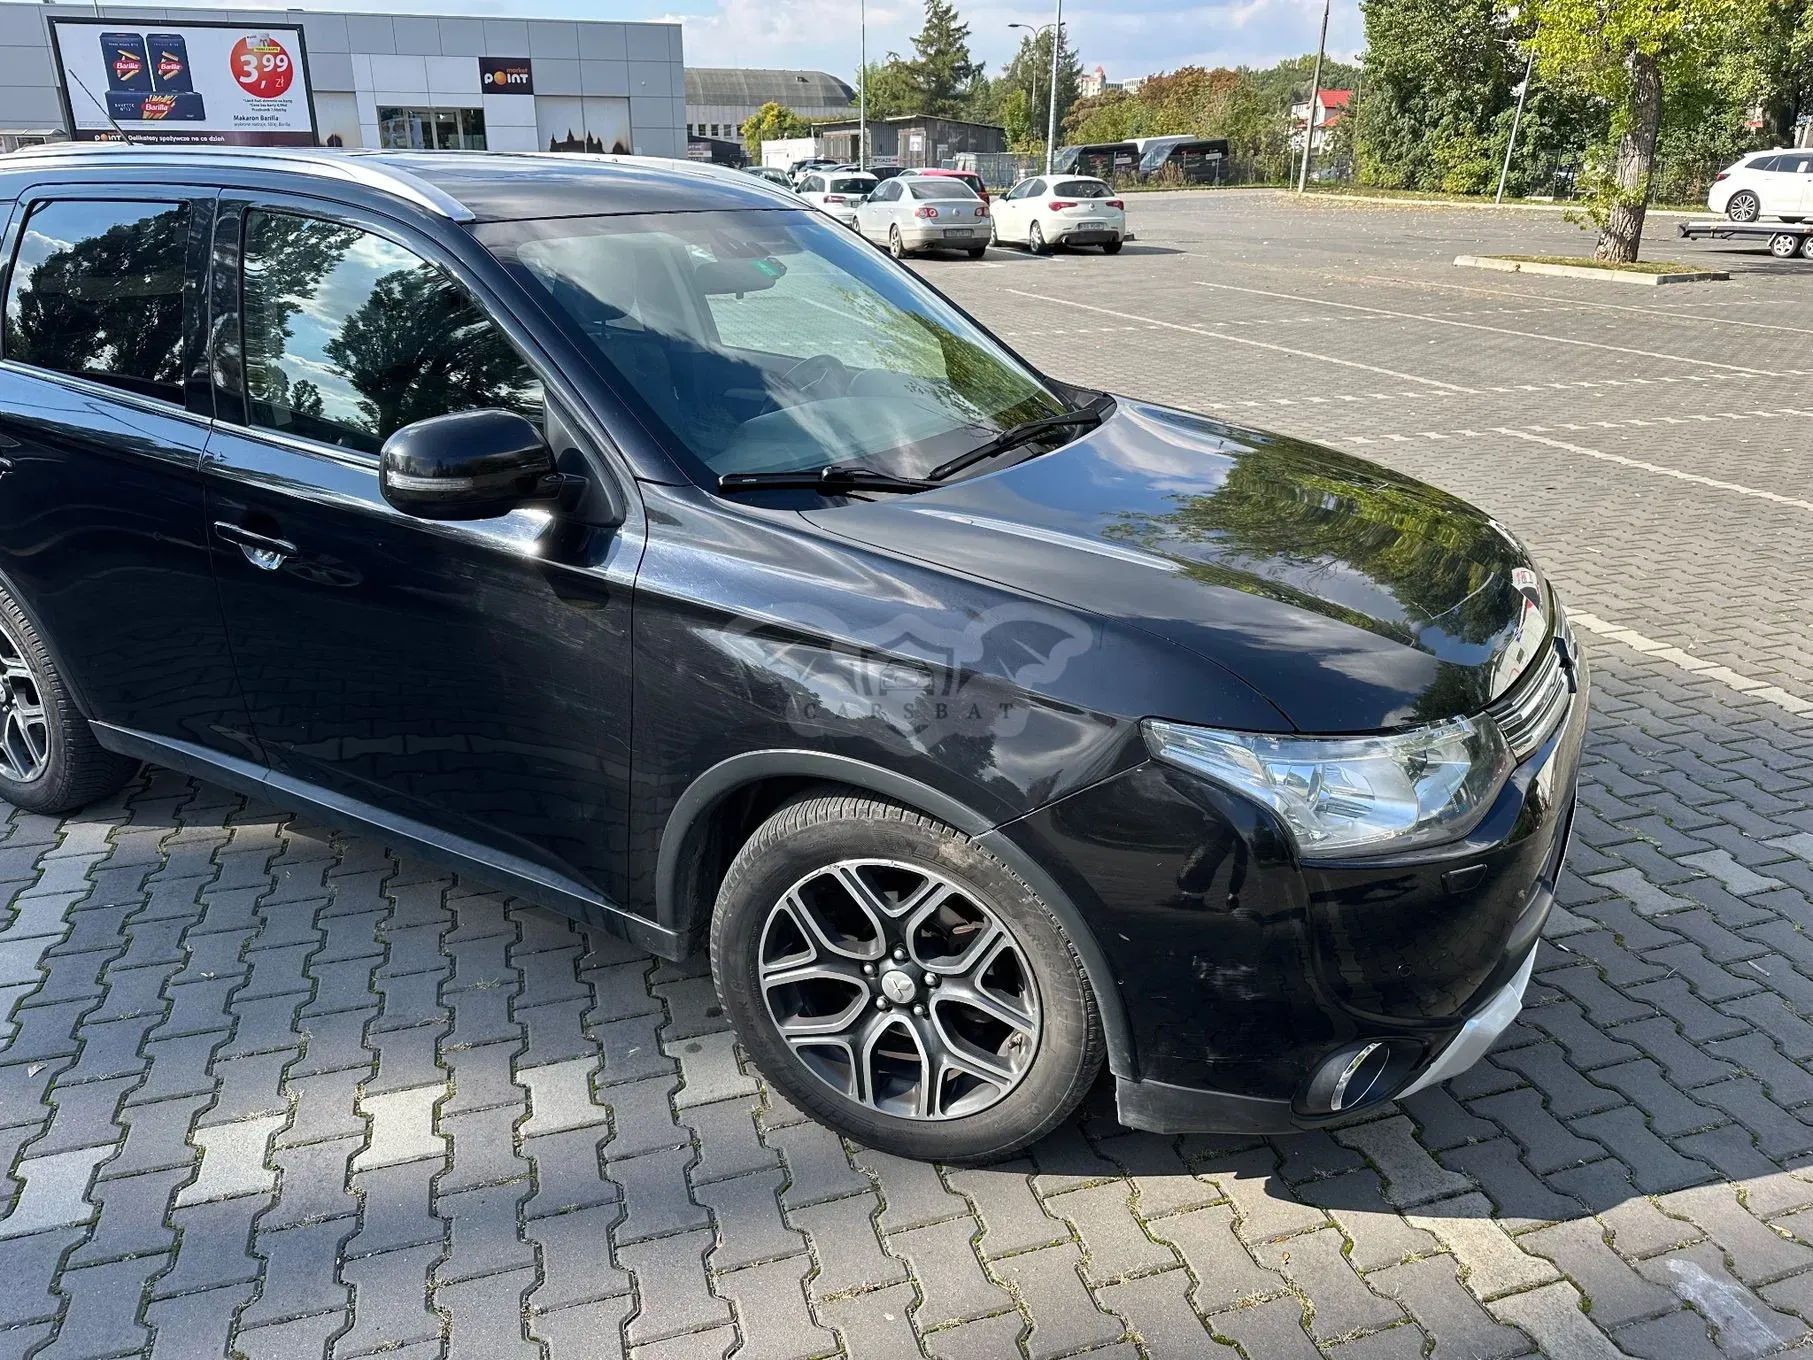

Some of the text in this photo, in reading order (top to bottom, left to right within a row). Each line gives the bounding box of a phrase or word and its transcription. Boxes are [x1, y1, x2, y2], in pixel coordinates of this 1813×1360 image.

[116, 62, 139, 70] Barilla
[160, 63, 181, 71] Barilla
[145, 103, 168, 111] Barilla
[127, 134, 158, 142] Delikatesy
